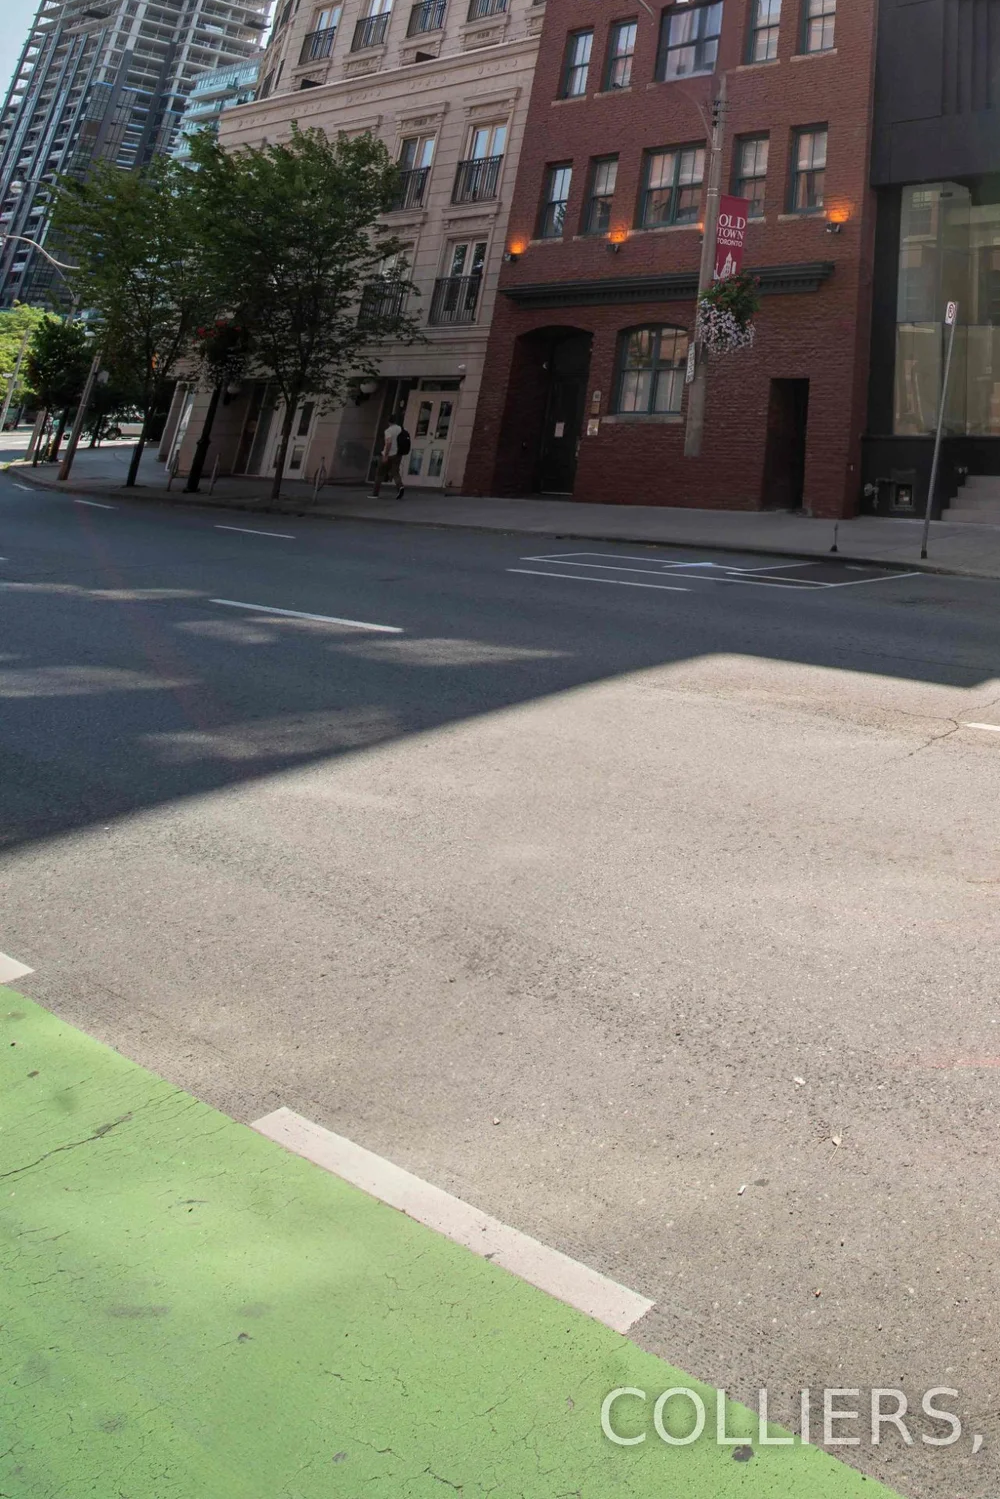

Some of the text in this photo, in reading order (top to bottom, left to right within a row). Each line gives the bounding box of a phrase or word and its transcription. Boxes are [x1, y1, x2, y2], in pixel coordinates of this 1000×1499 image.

[719, 213, 746, 230] OLD
[717, 227, 745, 240] TOWN
[717, 237, 743, 248] TORONTO
